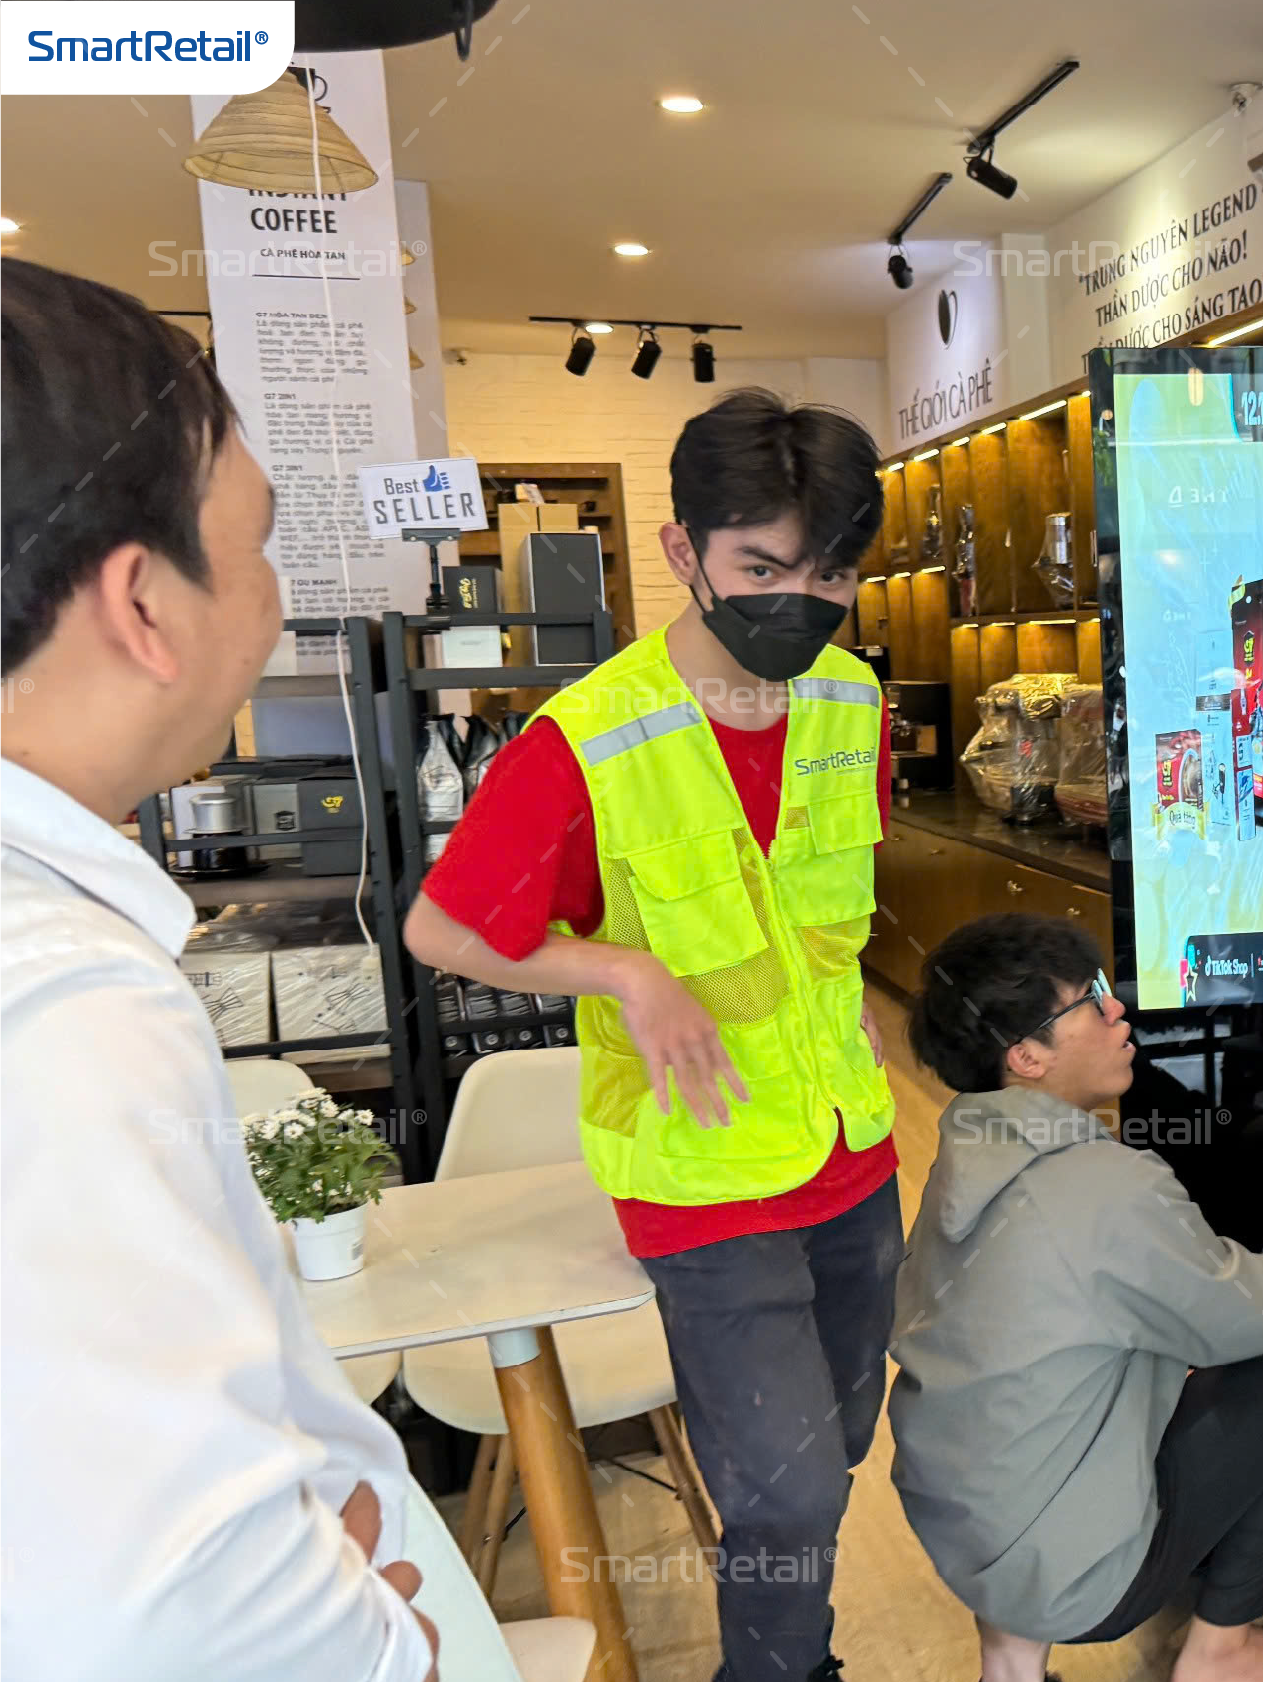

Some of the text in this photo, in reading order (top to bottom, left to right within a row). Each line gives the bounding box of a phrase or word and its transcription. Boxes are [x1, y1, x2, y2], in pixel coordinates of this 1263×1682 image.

[250, 207, 338, 233] COFFEE
[1130, 218, 1188, 272] NGUYÊN
[1193, 183, 1258, 238] LEGEND
[260, 248, 275, 258] CÀ
[277, 248, 298, 258] PHÊ
[325, 251, 346, 261] TAN
[1096, 288, 1128, 328] THẦN
[1131, 272, 1170, 314] DƯỢC
[1172, 257, 1203, 292] CHO
[1152, 313, 1183, 345] CHO
[1185, 294, 1223, 331] SÁNG
[948, 371, 967, 419] CÀ
[968, 357, 993, 412] PHÊ
[383, 477, 421, 496] Best
[373, 492, 477, 525] SELLER
[1211, 959, 1232, 976] TikTok
[1233, 958, 1248, 979] Shop
